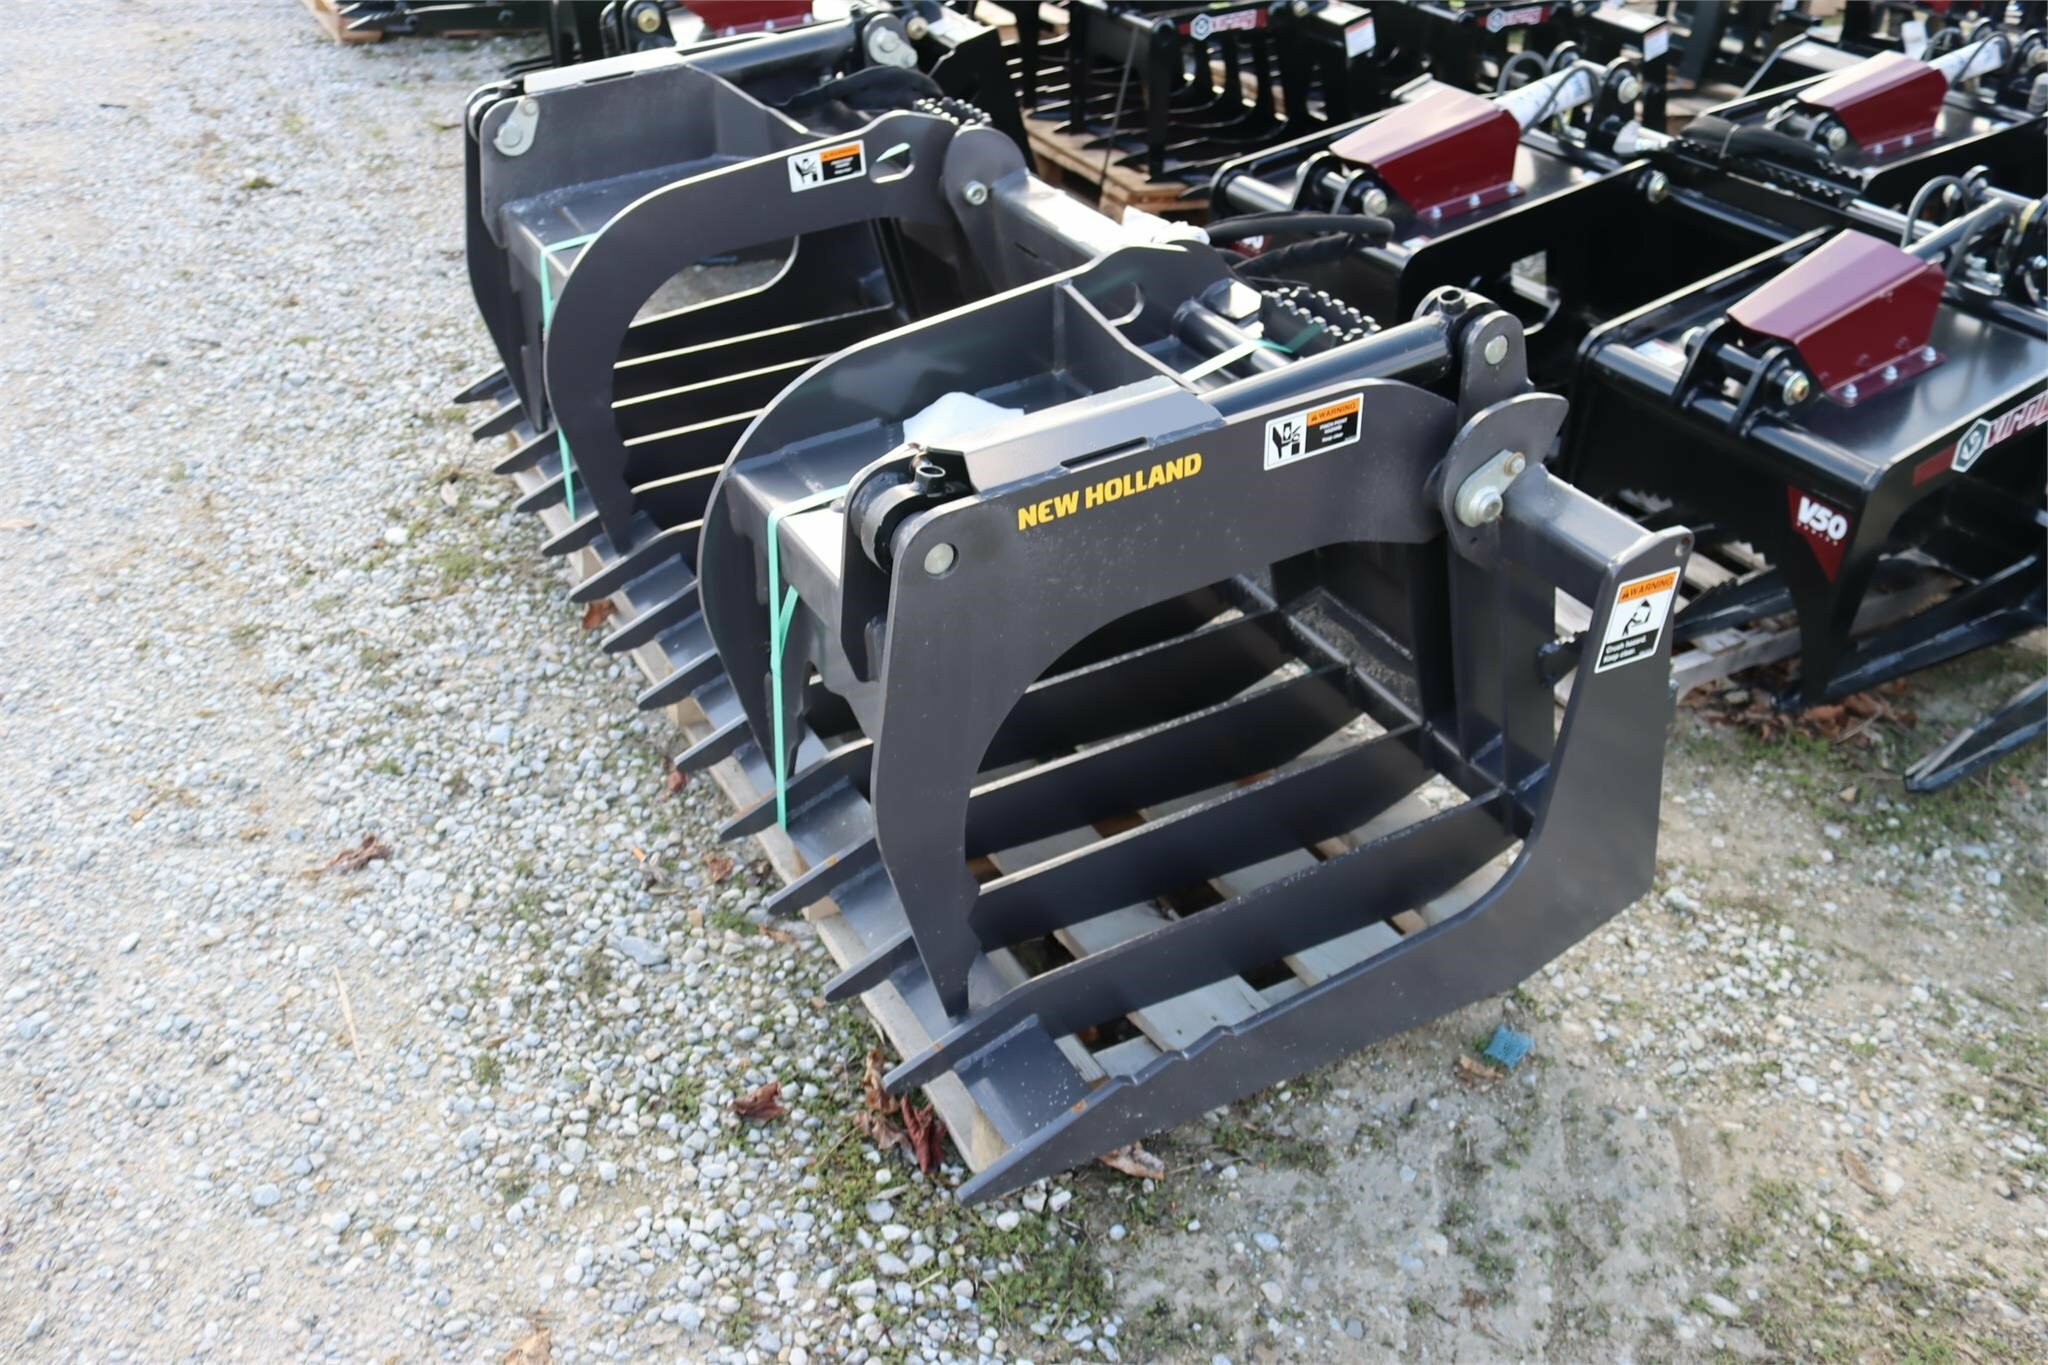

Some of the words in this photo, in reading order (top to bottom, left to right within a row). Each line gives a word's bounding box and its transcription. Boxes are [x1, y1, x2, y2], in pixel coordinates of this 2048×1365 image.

[1319, 402, 1356, 418] WARNING
[1017, 490, 1080, 531] NEW
[1085, 452, 1203, 510] HOLLAND
[1797, 496, 1848, 541] V50
[1630, 577, 1674, 595] WARNING
